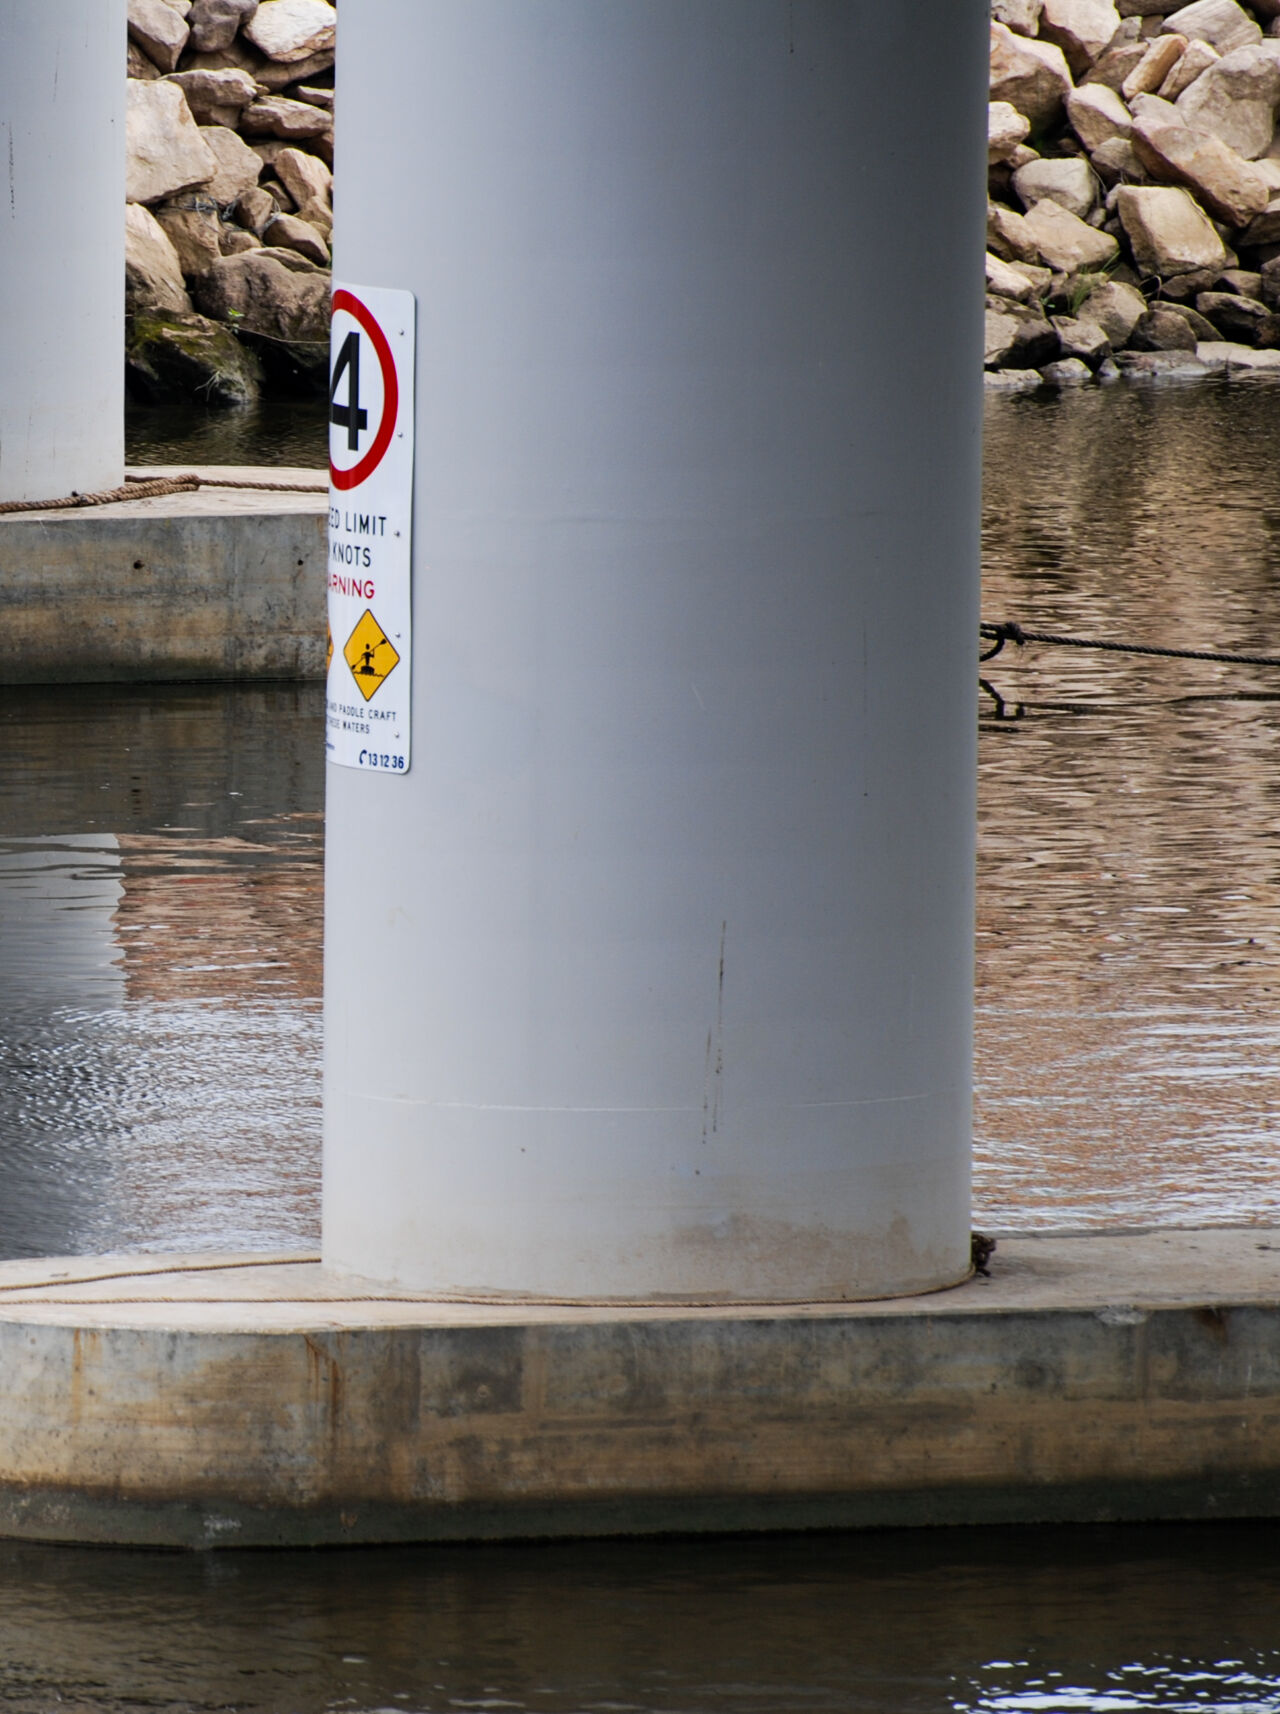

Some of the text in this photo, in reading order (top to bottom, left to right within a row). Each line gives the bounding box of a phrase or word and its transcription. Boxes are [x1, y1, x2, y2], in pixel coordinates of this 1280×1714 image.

[325, 331, 367, 451] 4
[345, 511, 387, 536] LIMIT
[333, 541, 371, 567] KNOTS
[339, 703, 364, 719] PADDLE
[368, 708, 396, 721] CRAFT
[343, 720, 370, 734] WATERS
